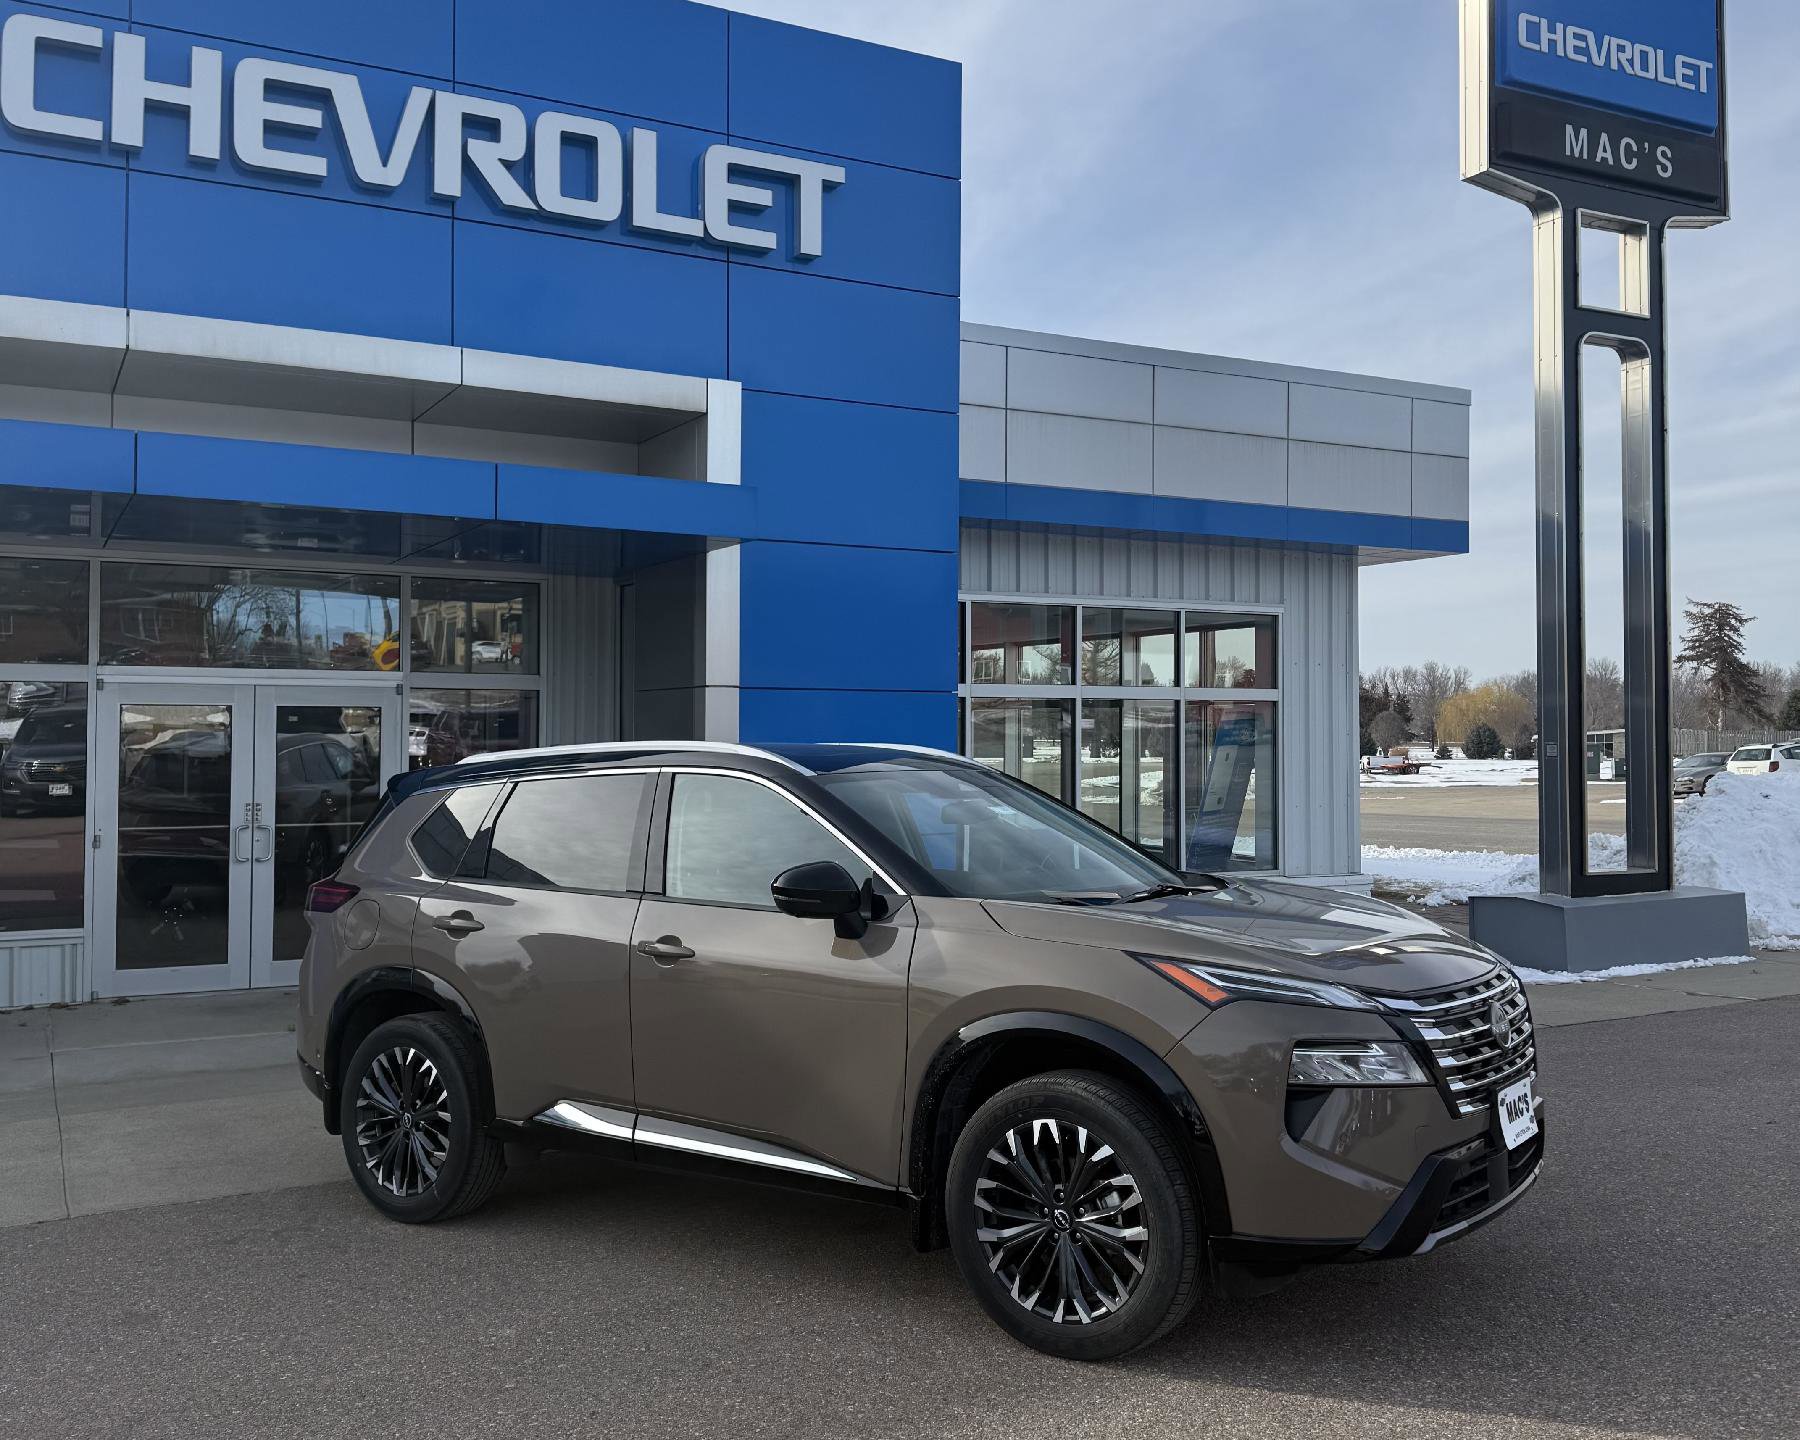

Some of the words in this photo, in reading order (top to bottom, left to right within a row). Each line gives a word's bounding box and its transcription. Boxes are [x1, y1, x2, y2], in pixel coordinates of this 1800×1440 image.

[1518, 12, 1713, 93] CHEVROLET
[0, 13, 846, 260] CHEVROLET
[1565, 123, 1673, 178] MAC'S
[1506, 1093, 1529, 1124] MAC'S
